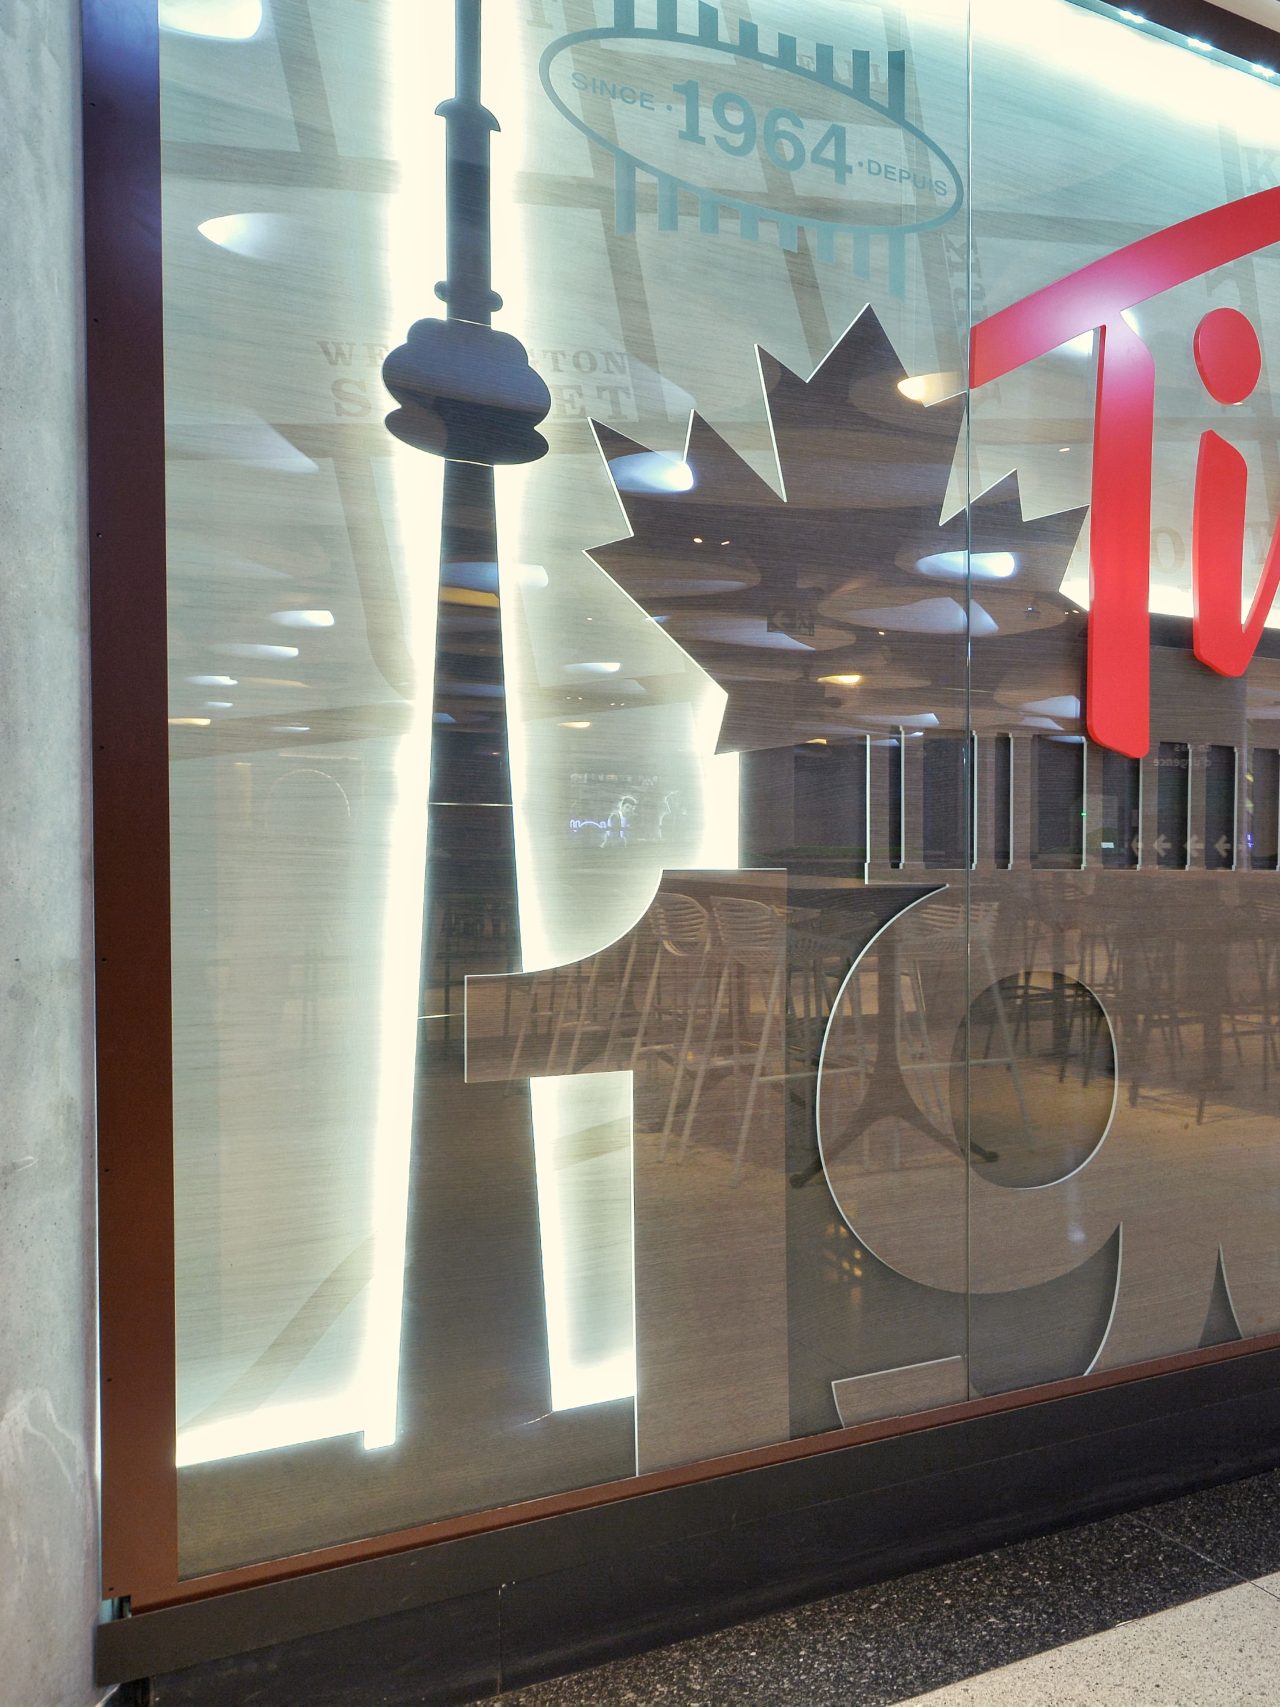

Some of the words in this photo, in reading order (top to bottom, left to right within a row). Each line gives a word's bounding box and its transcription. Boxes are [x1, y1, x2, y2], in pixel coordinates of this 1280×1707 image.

[571, 72, 656, 110] SINCE
[672, 79, 853, 186] 1964
[868, 159, 947, 197] DEPUIS
